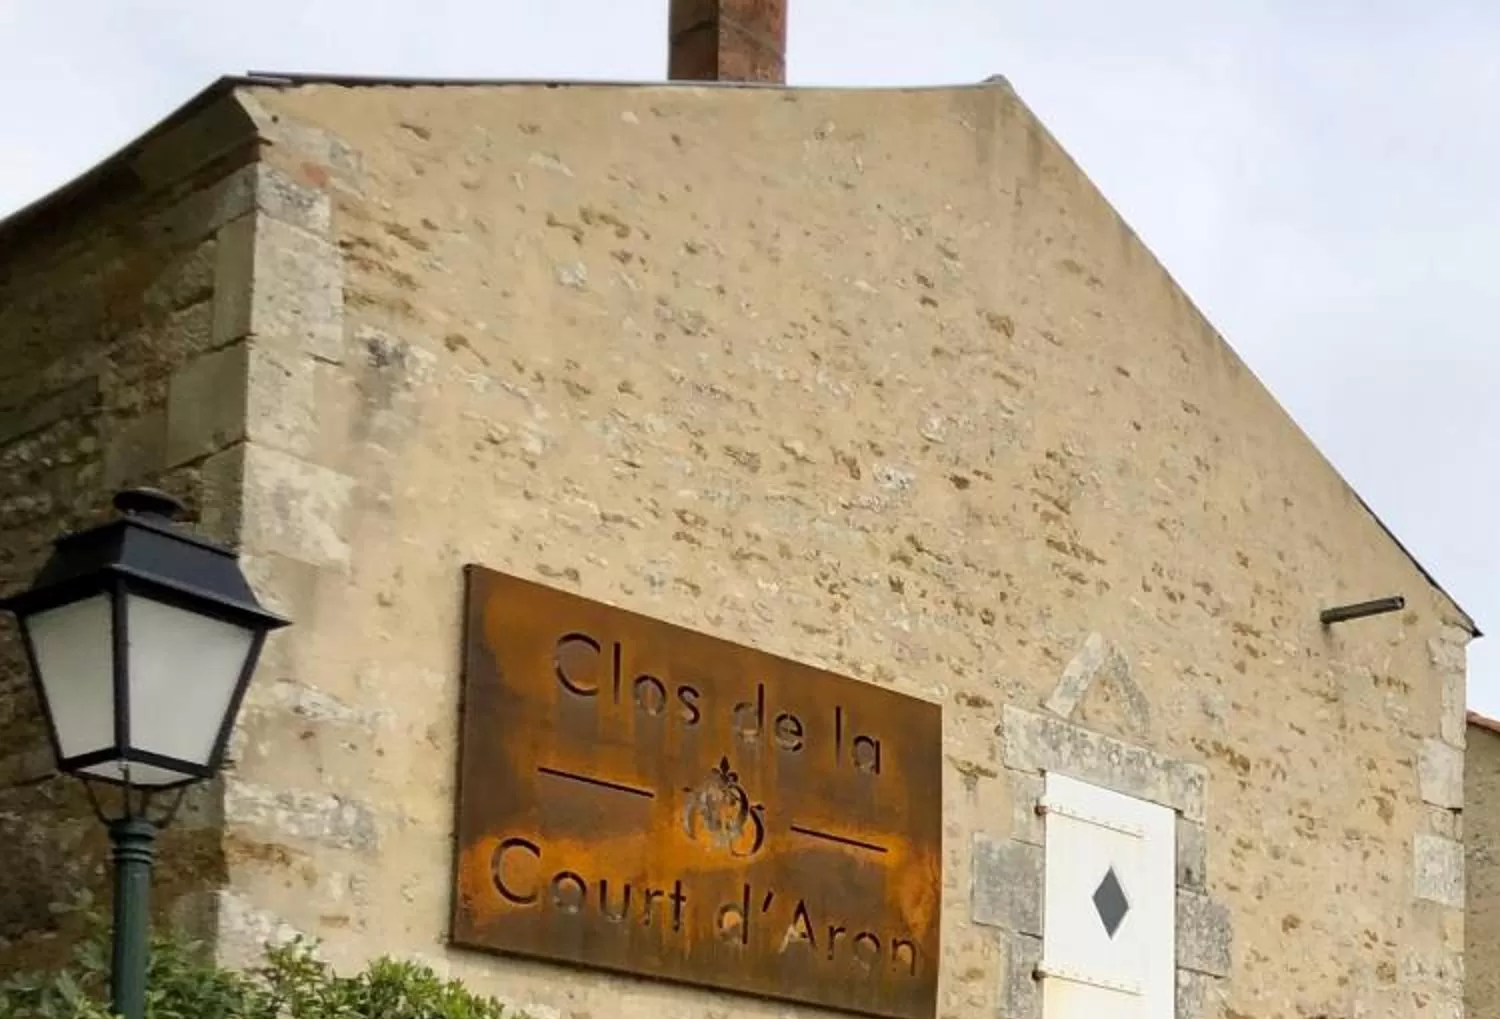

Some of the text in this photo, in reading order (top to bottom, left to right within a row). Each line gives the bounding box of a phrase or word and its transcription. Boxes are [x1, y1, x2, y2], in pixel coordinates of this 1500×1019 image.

[555, 633, 882, 775] Clos de la
[491, 837, 918, 977] Court d'Aron
